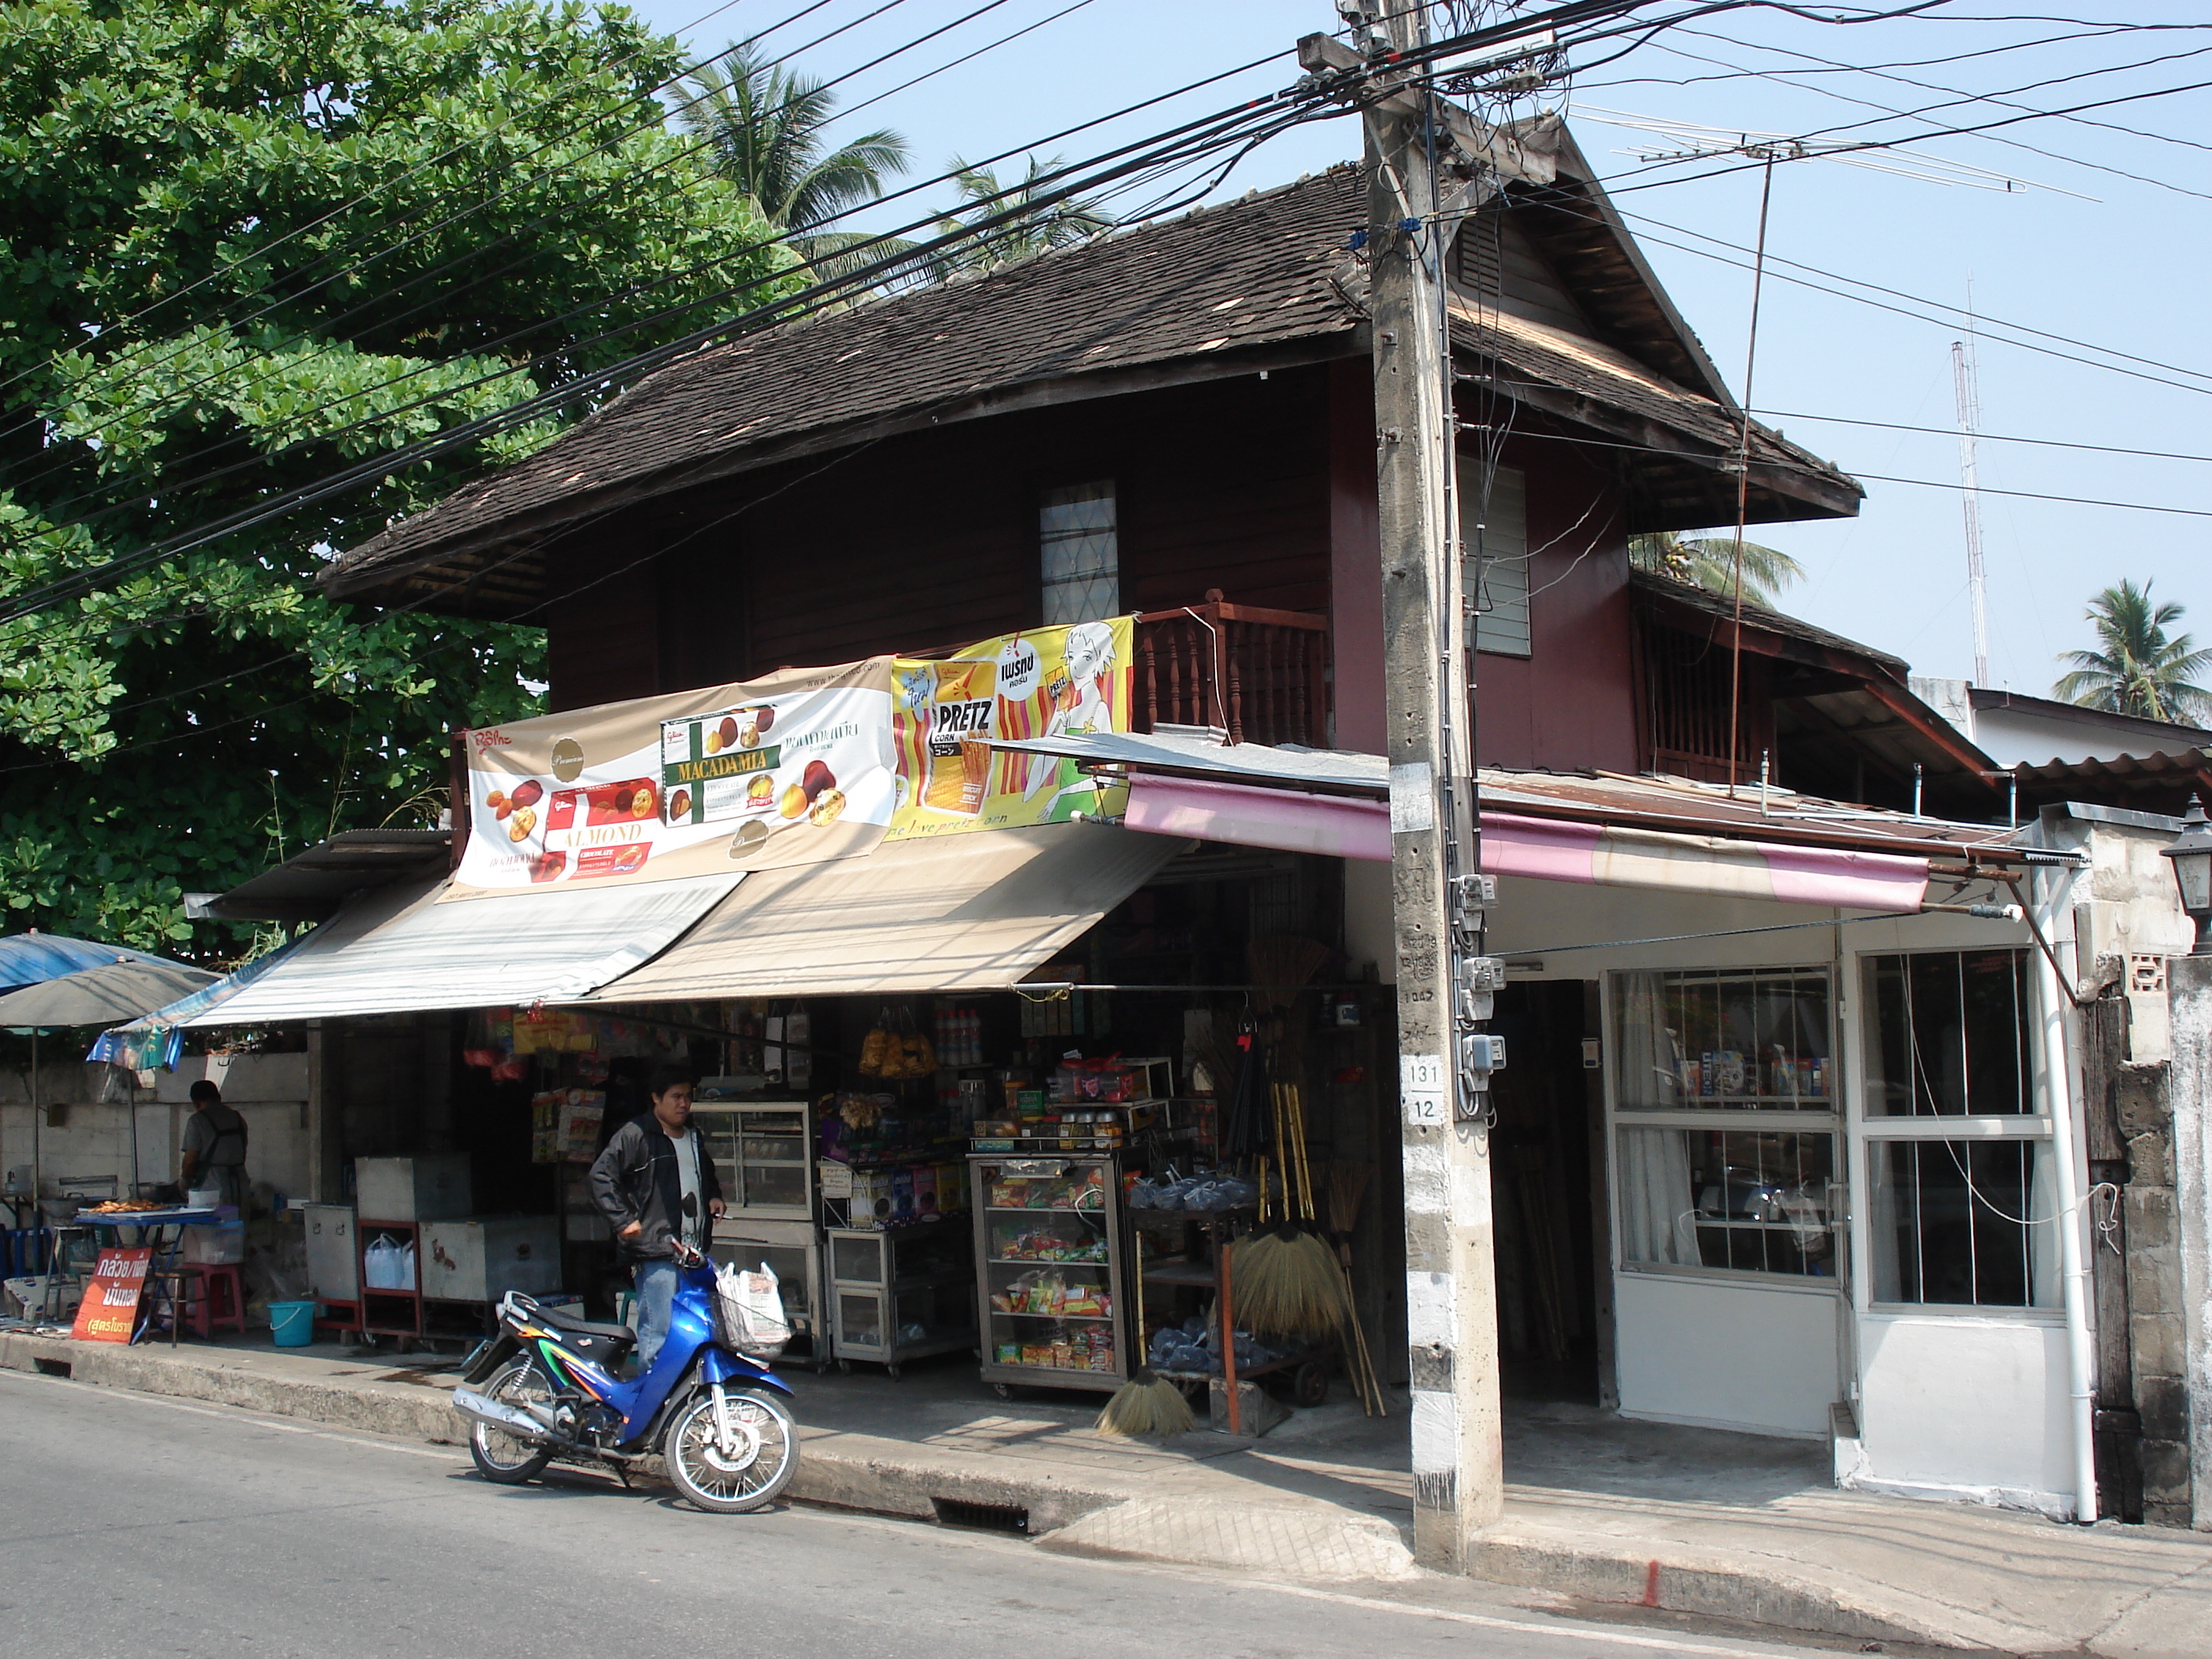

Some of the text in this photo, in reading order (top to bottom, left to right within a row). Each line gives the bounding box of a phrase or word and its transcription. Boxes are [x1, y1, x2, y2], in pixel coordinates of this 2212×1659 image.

[1049, 676, 1067, 694] PRETZ
[938, 701, 992, 733] PRETZ
[934, 734, 955, 742] CORN
[551, 755, 584, 767] Premium
[677, 750, 767, 782] MACADAMIA
[908, 819, 935, 834] love
[565, 823, 642, 848] ALMOND
[1411, 1065, 1437, 1082] 131
[1415, 1101, 1435, 1118] 12
